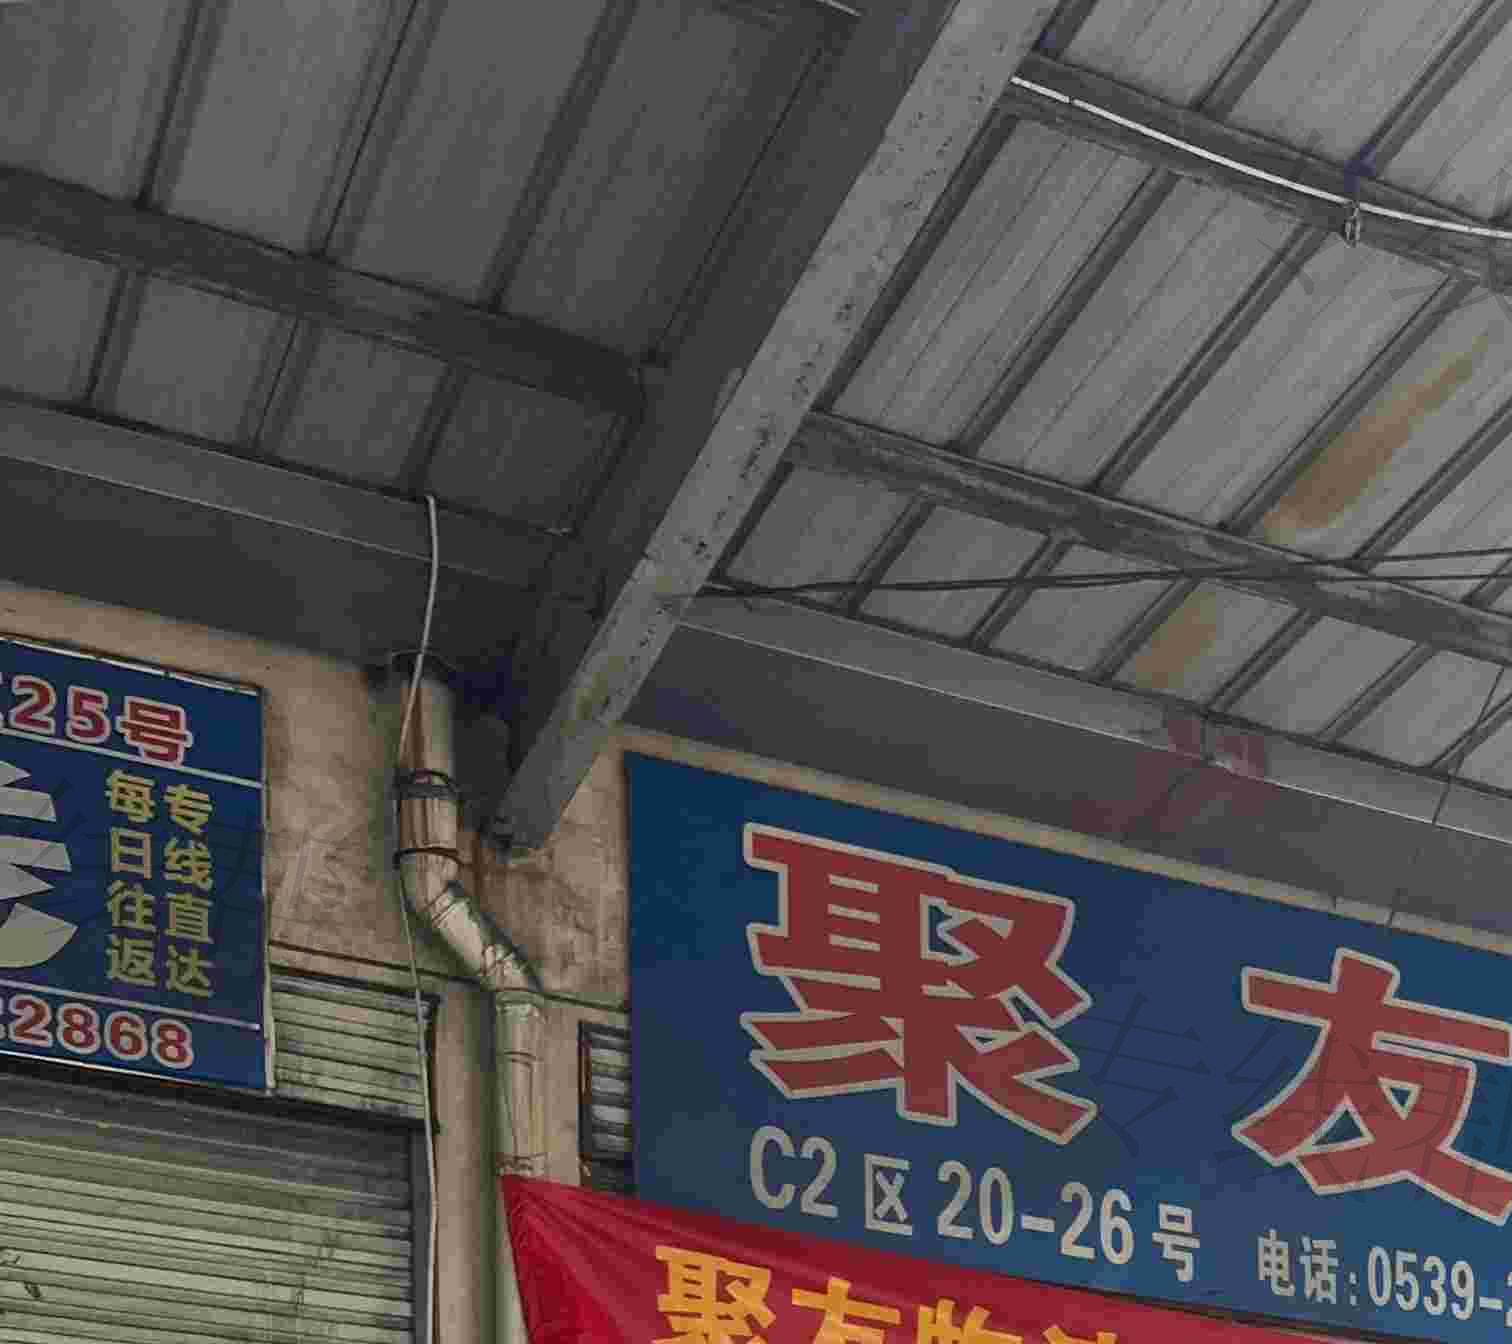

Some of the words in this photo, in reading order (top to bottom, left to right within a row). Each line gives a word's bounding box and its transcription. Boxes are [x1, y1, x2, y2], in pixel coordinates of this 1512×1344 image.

[0, 673, 193, 768] 25号
[106, 769, 159, 988] 每日往返
[163, 783, 214, 998] 专线直达
[0, 993, 195, 1070] 2868
